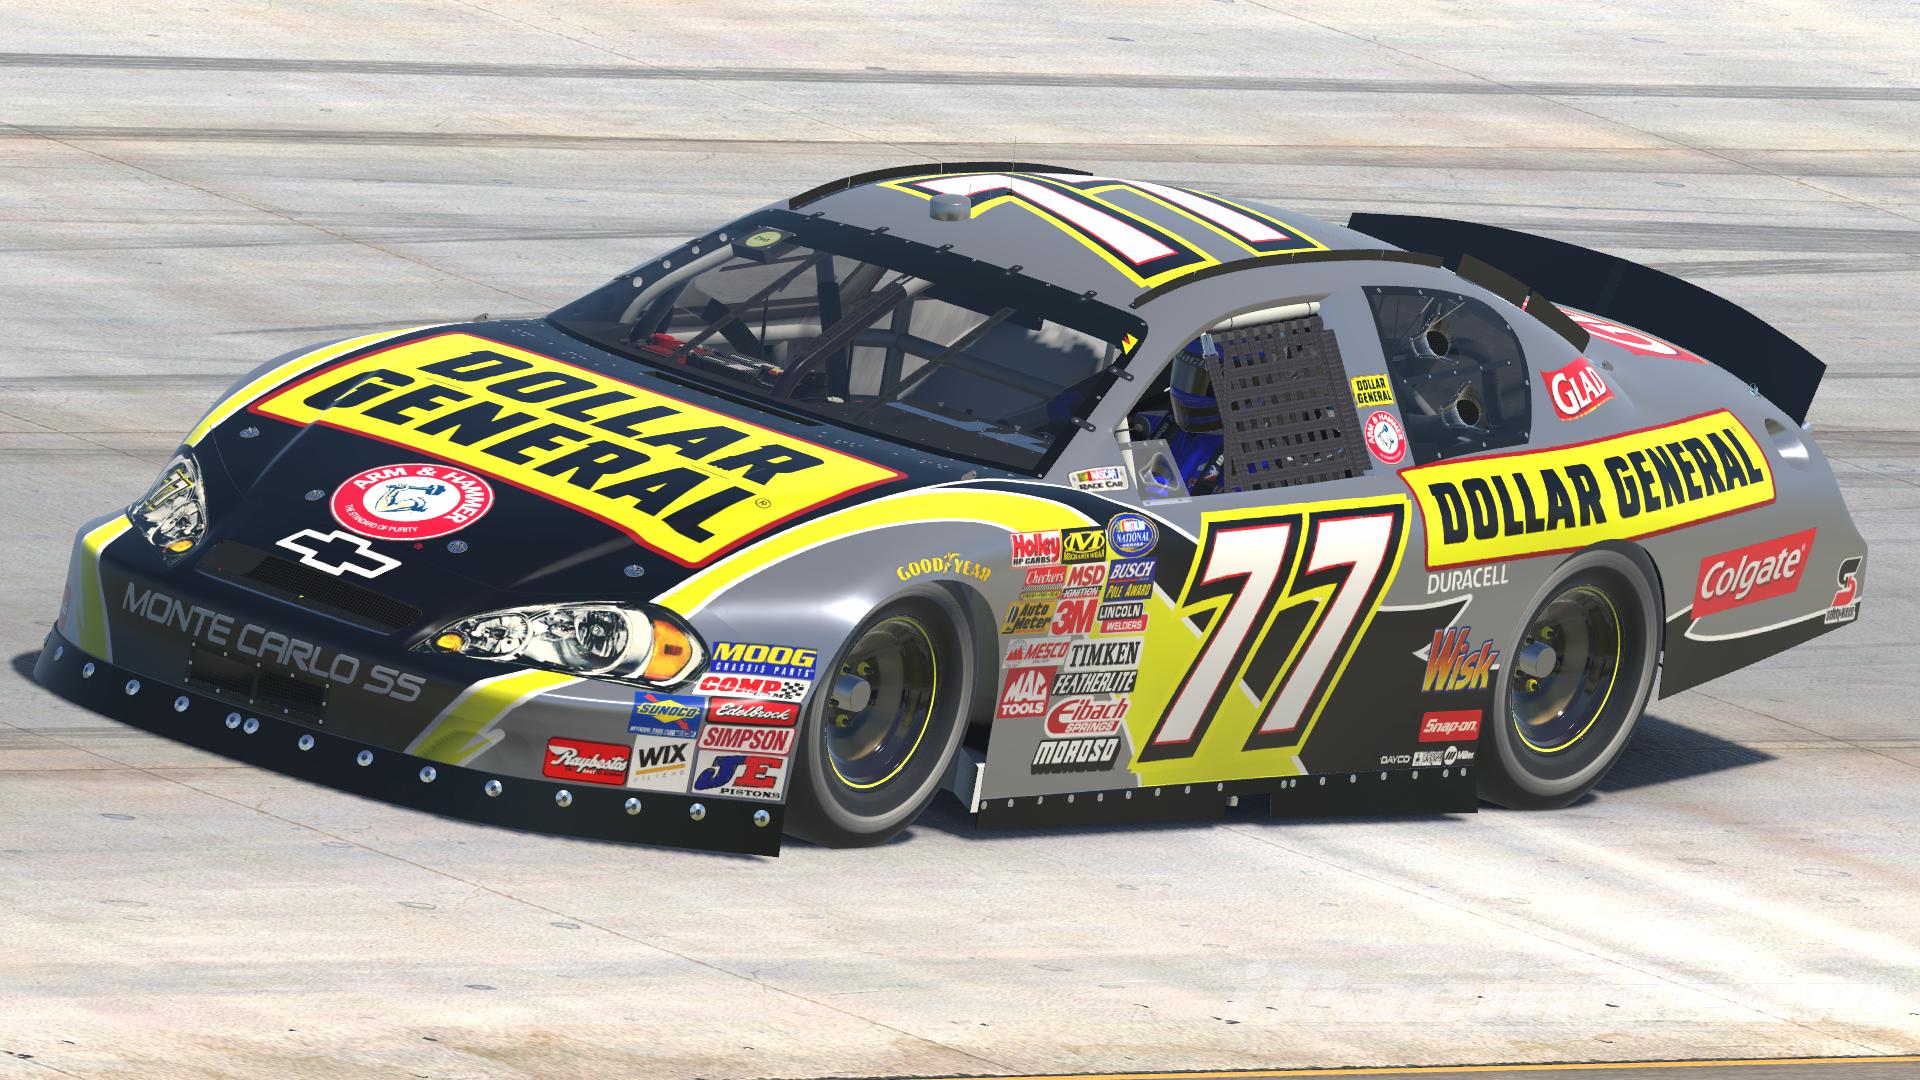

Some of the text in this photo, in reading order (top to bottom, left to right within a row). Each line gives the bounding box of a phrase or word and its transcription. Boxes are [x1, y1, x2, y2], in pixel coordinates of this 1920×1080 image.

[1356, 378, 1387, 391] DOLLAR
[1551, 366, 1607, 415] GLAD
[1357, 391, 1393, 404] GENERAL
[416, 350, 824, 485] DOLLAR
[1367, 423, 1376, 445] ARM
[1378, 413, 1404, 441] HAMMER
[303, 368, 756, 543] GENERAL
[1079, 480, 1123, 490] RACE CAR
[1428, 428, 1764, 545] DOLLAR GENERAL
[353, 467, 485, 524] ARM & HAMMER
[377, 523, 389, 531] OF
[388, 525, 419, 533] PURITY
[1117, 532, 1149, 543] NATIONAL
[1012, 533, 1061, 562] Holley
[896, 555, 991, 582] GOODYEAR
[1013, 556, 1051, 566] HP CARBS
[1110, 561, 1155, 579] BUSCH
[1026, 569, 1063, 585] Checkers
[1067, 565, 1106, 586] MSD
[1427, 564, 1509, 595] DURACELL
[1701, 547, 1802, 600] Colgate
[1064, 587, 1099, 598] IGNITION
[1106, 583, 1152, 598] POLE AWARD
[1020, 602, 1049, 617] Auto
[1051, 599, 1098, 635] 3M
[1099, 604, 1142, 618] LINCOLN
[1013, 617, 1051, 630] Meter
[1106, 620, 1142, 631] WELDERS
[1137, 503, 1405, 763] 77
[122, 582, 235, 646] MONTE
[237, 623, 360, 684] CARLO
[363, 664, 427, 702] SS
[1024, 641, 1070, 660] MESCO
[713, 643, 817, 668] MOOG
[1069, 641, 1141, 668] TIMKEN
[1421, 626, 1499, 692] Wisk
[715, 662, 811, 678] CHASSIS PARTS
[700, 676, 782, 693] COMP
[1052, 671, 1135, 695] FEATHERLITE
[639, 703, 698, 718] SUNOCO
[716, 702, 792, 720] Edelbrock
[1001, 703, 1045, 716] TOOLS
[1047, 697, 1129, 734] Eibach
[1065, 720, 1114, 733] SPRINGS
[1423, 718, 1478, 735] Snap-on
[703, 727, 792, 751] SIMPSON
[548, 744, 628, 773] Raybestos
[639, 743, 688, 768] WIX
[1032, 738, 1120, 767] MOROSO
[1380, 754, 1412, 764] DAYCO
[694, 755, 785, 791] JE
[720, 787, 781, 799] PISTONS
